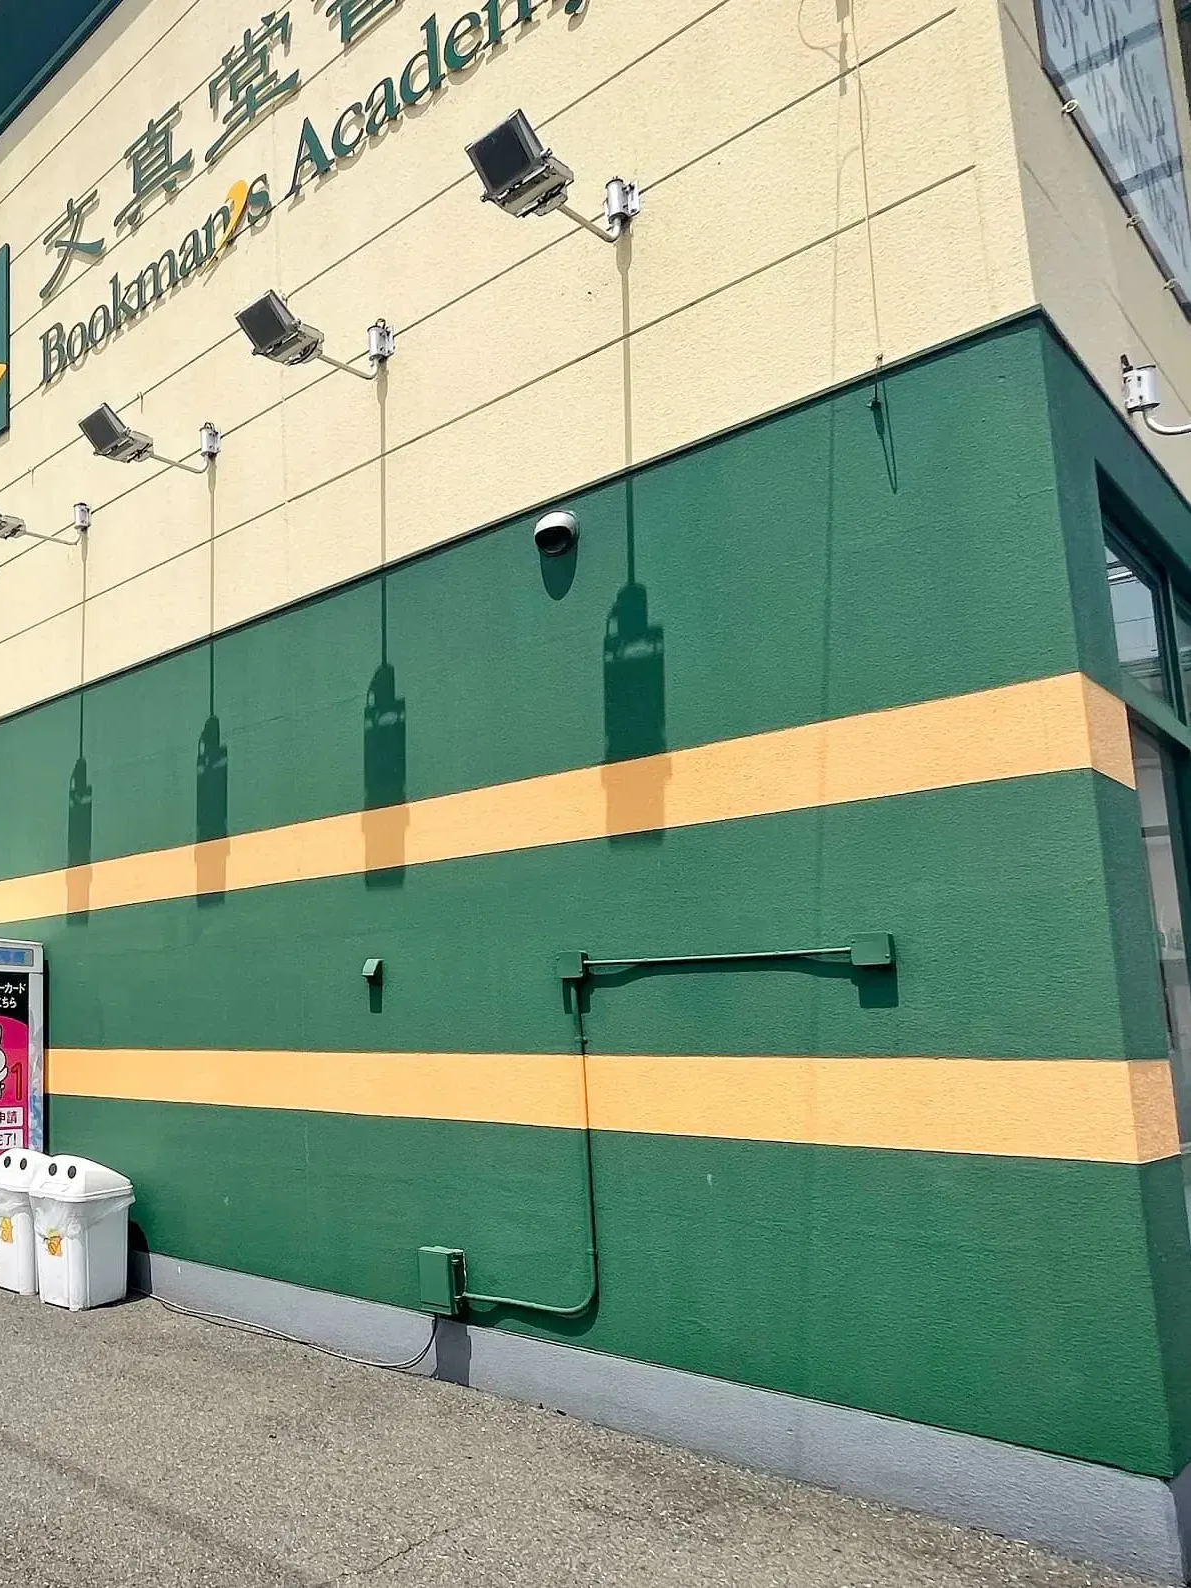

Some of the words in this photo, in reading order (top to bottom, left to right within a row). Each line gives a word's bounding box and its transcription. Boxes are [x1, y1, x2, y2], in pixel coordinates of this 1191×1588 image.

[39, 0, 401, 299] 文真堂
[39, 173, 270, 386] Bookman's
